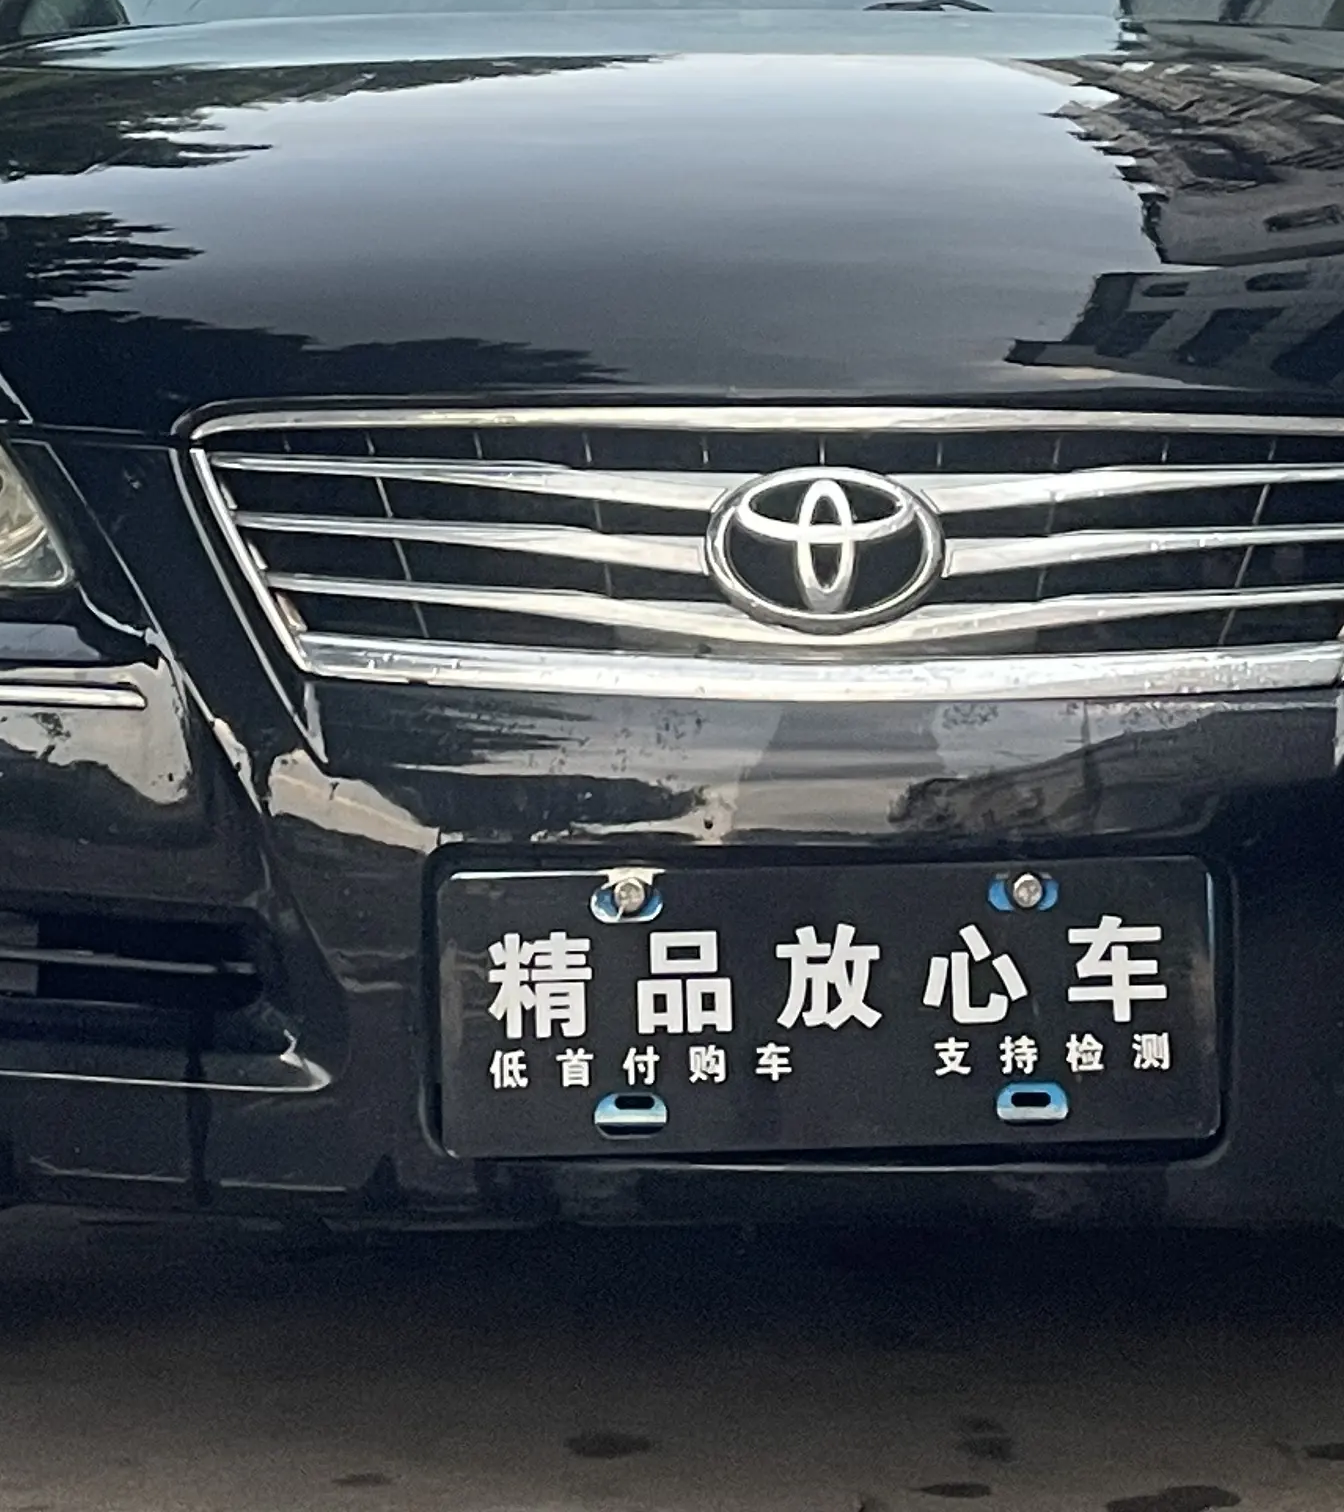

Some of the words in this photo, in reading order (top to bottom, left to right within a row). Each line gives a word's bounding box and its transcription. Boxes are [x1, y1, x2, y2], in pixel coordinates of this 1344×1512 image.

[487, 914, 1169, 1040] 精品放心车
[489, 1042, 794, 1089] 低首付购车
[933, 1032, 1173, 1078] 支持检测
